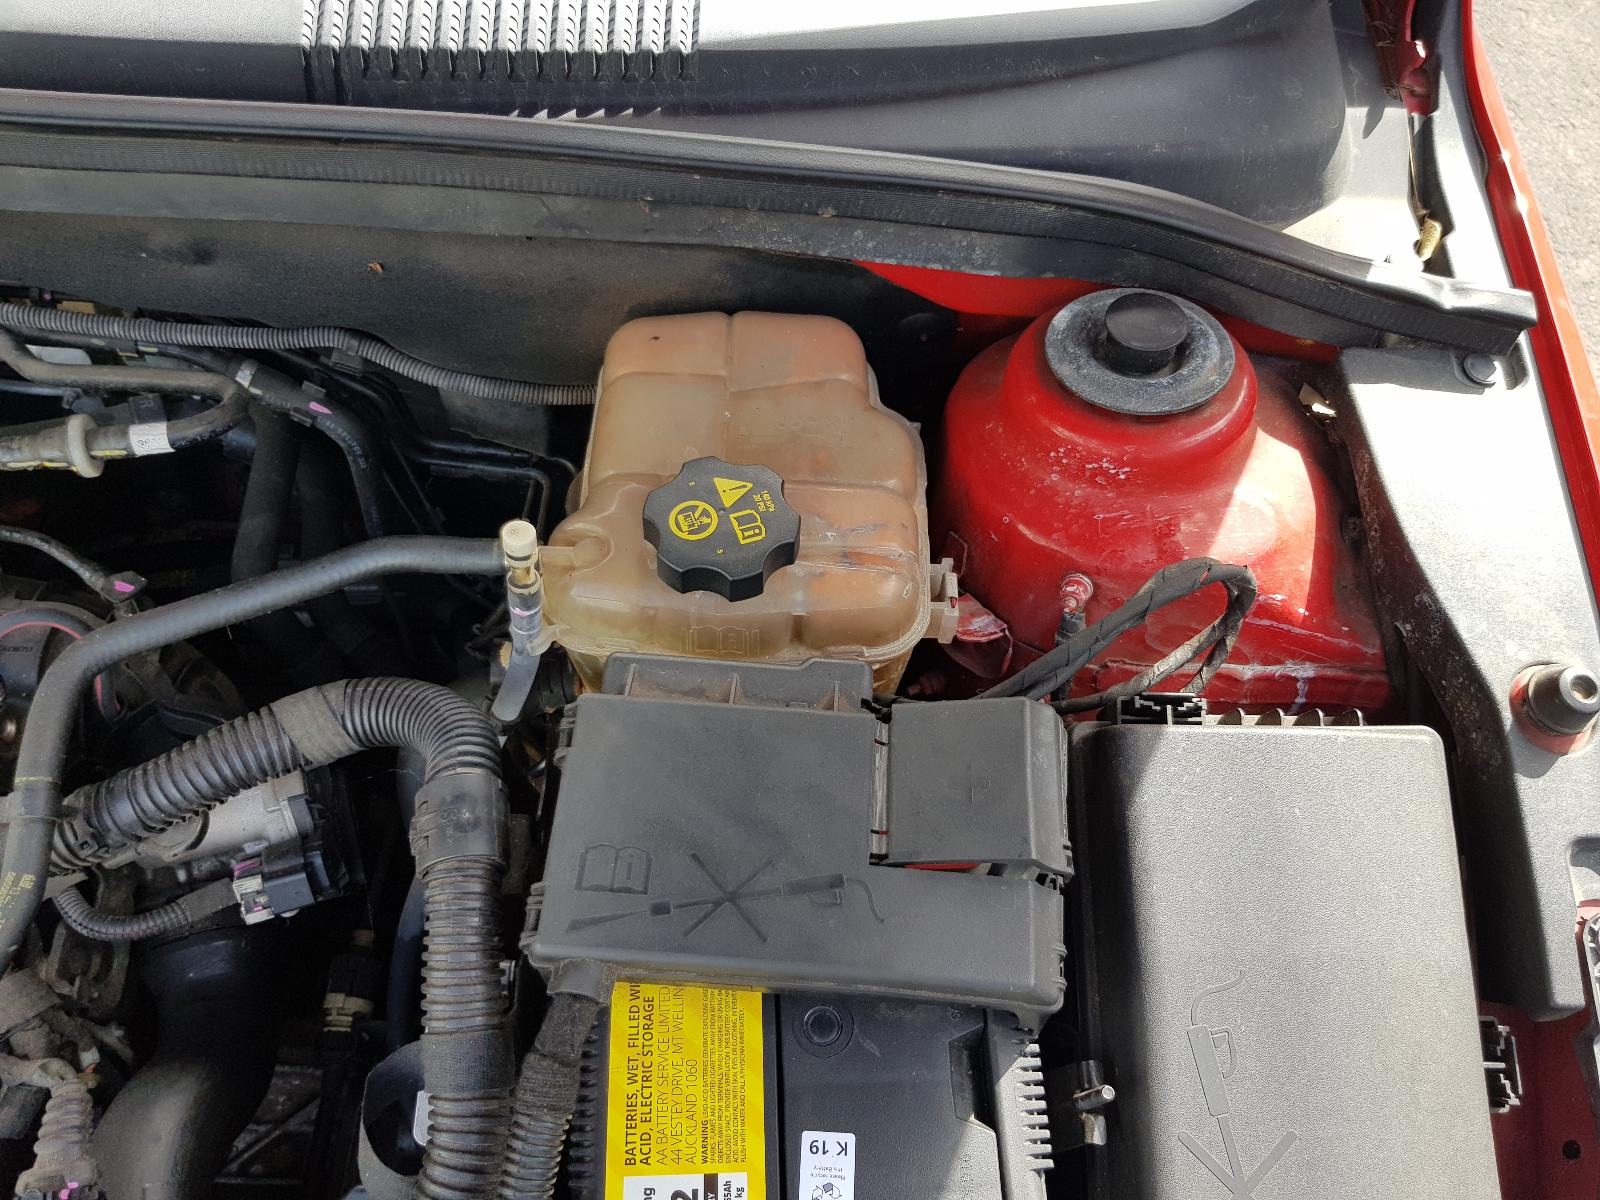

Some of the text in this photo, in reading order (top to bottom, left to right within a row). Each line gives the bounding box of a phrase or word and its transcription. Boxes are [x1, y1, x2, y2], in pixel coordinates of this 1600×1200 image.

[628, 1005, 640, 1048] FILLED
[626, 1053, 641, 1086] WET,
[640, 996, 654, 1166] ACID, ELECTRIC STORAGE
[656, 986, 670, 1166] AA BATTERY SERVICE LIMITED
[670, 988, 684, 1165] 44 VESTEY DRIVE, MT WELLIN
[624, 1090, 640, 1166] BATTERIES,
[685, 1060, 697, 1164] AUCKLAND 1060
[810, 1140, 847, 1156] K 19
[734, 1187, 744, 1198] kg
